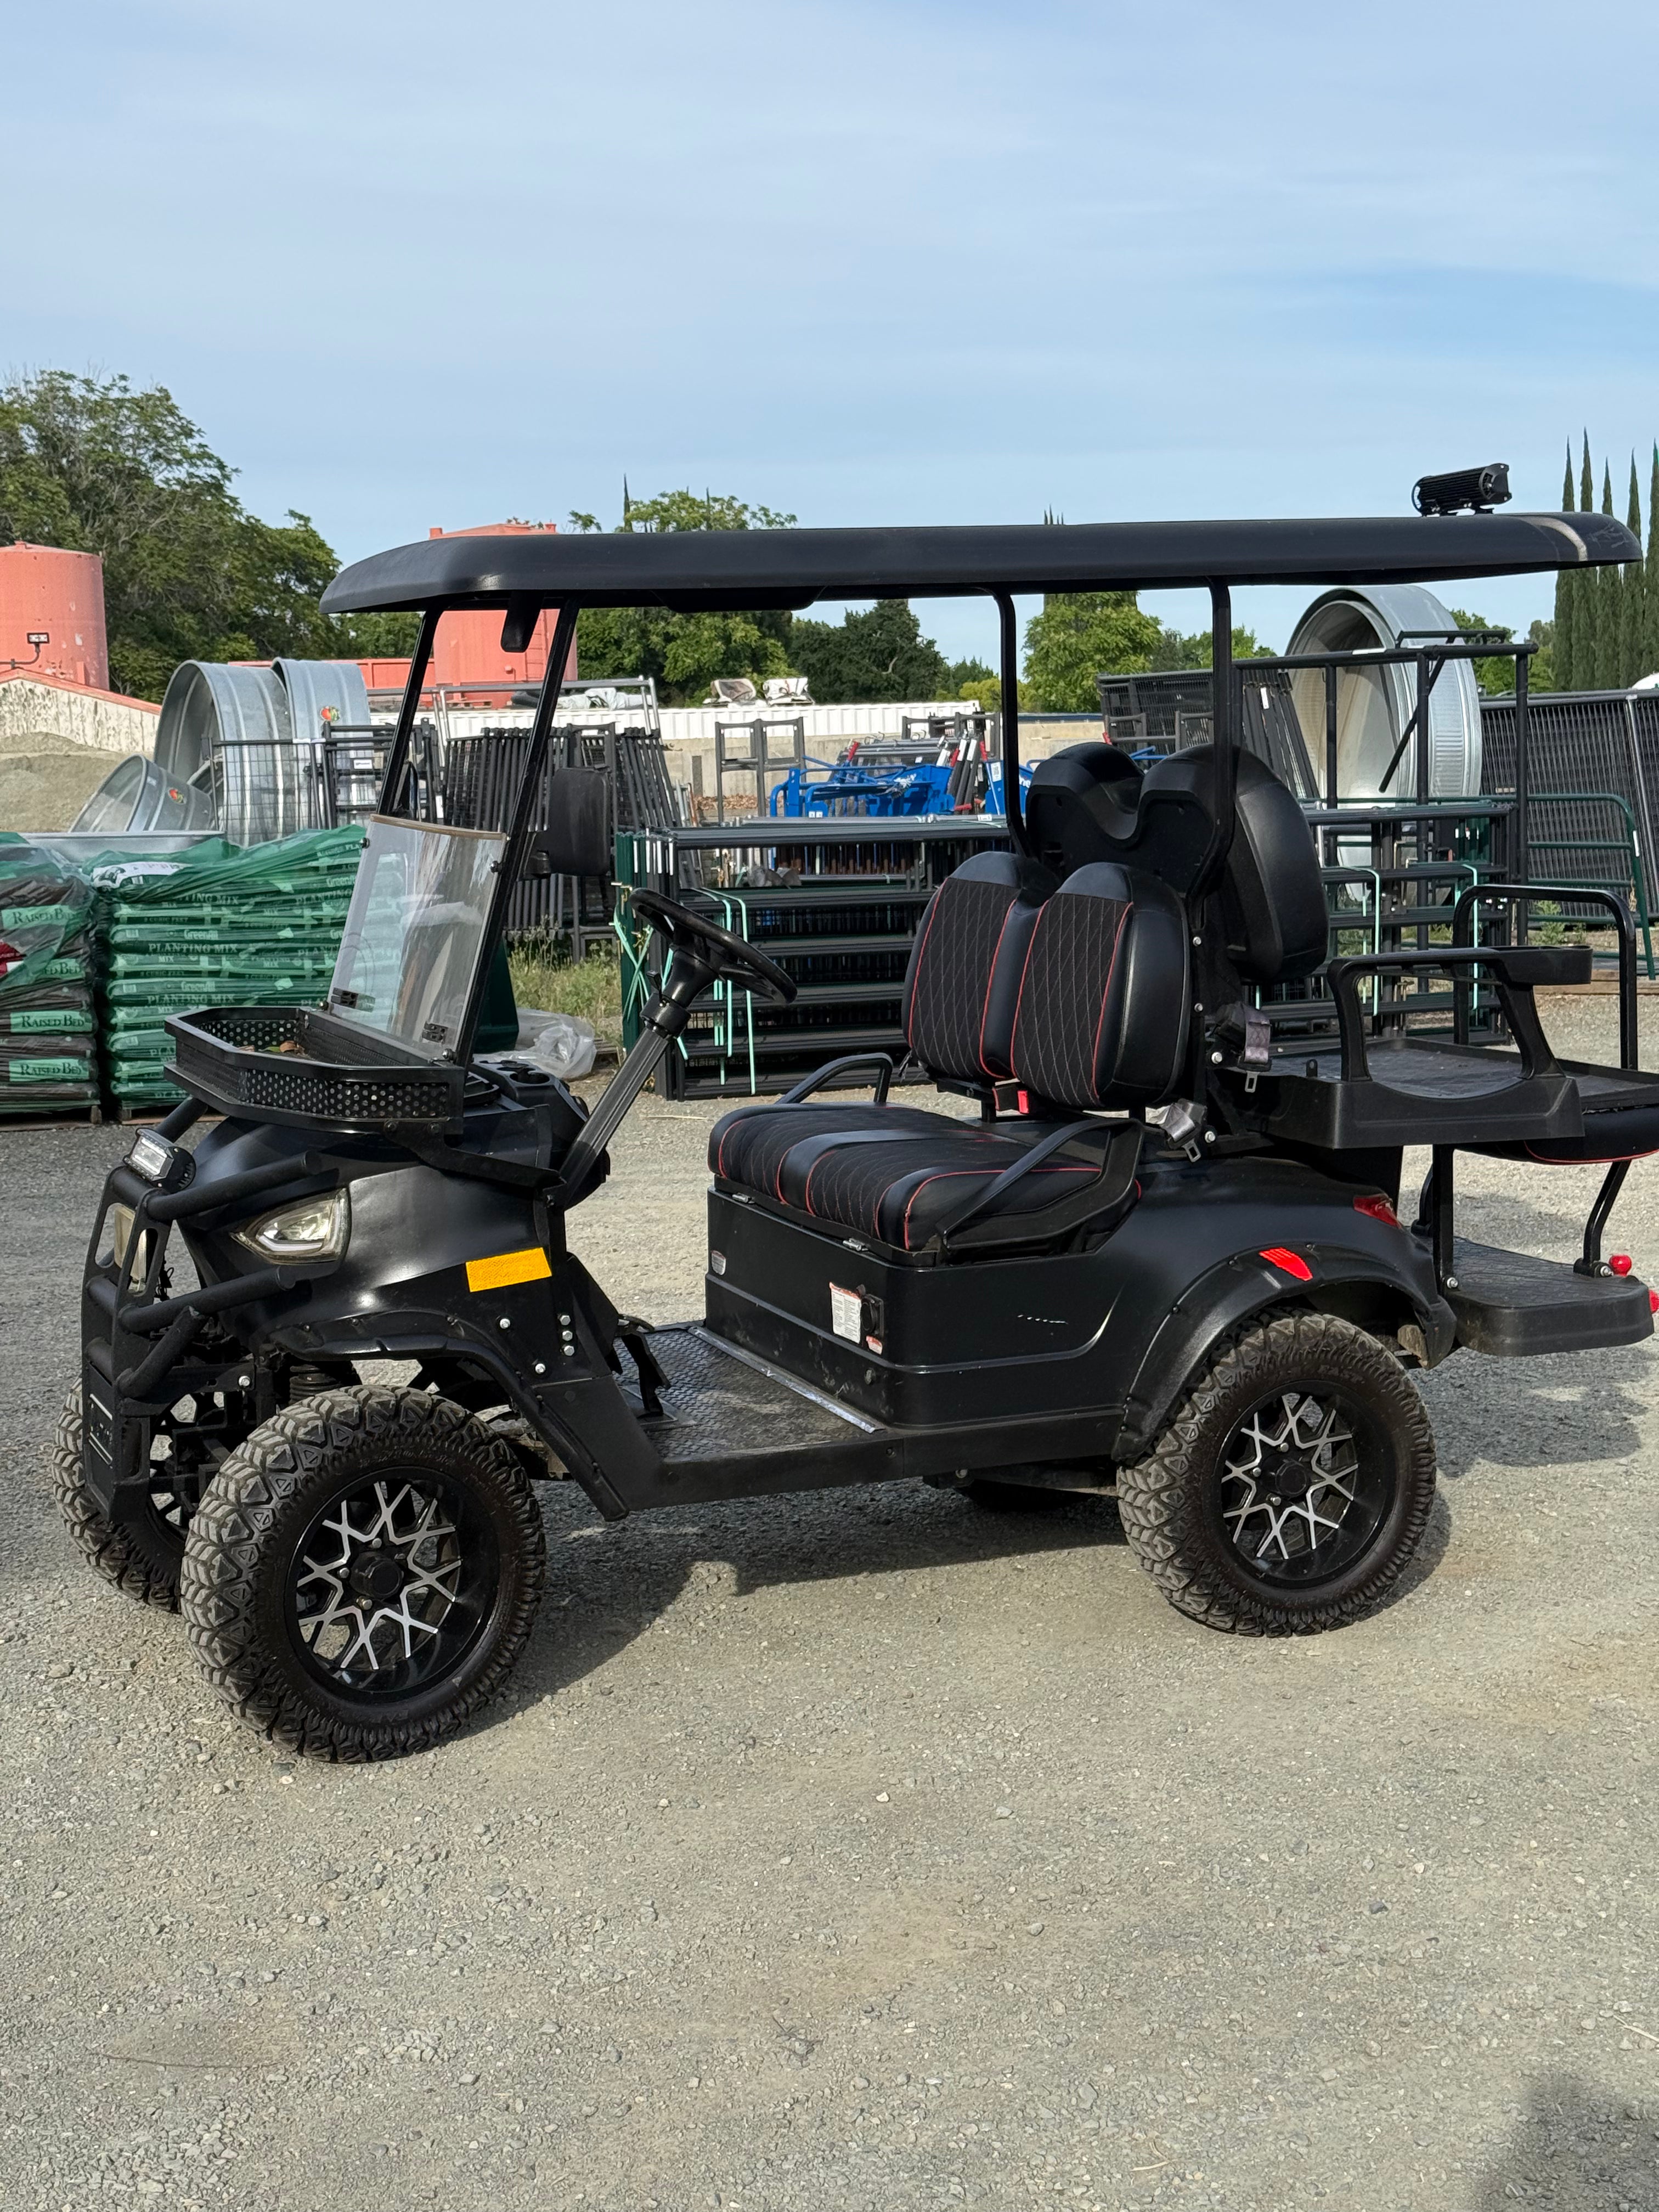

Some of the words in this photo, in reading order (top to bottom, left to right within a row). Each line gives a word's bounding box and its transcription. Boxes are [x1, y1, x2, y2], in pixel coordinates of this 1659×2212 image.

[216, 895, 239, 905] MIX
[148, 943, 211, 953] PLANTING
[214, 944, 238, 953] MIX
[147, 994, 207, 1005] PLANTING
[211, 994, 235, 1004] MIX
[21, 1015, 62, 1028] RAISED
[63, 1014, 84, 1027] BED
